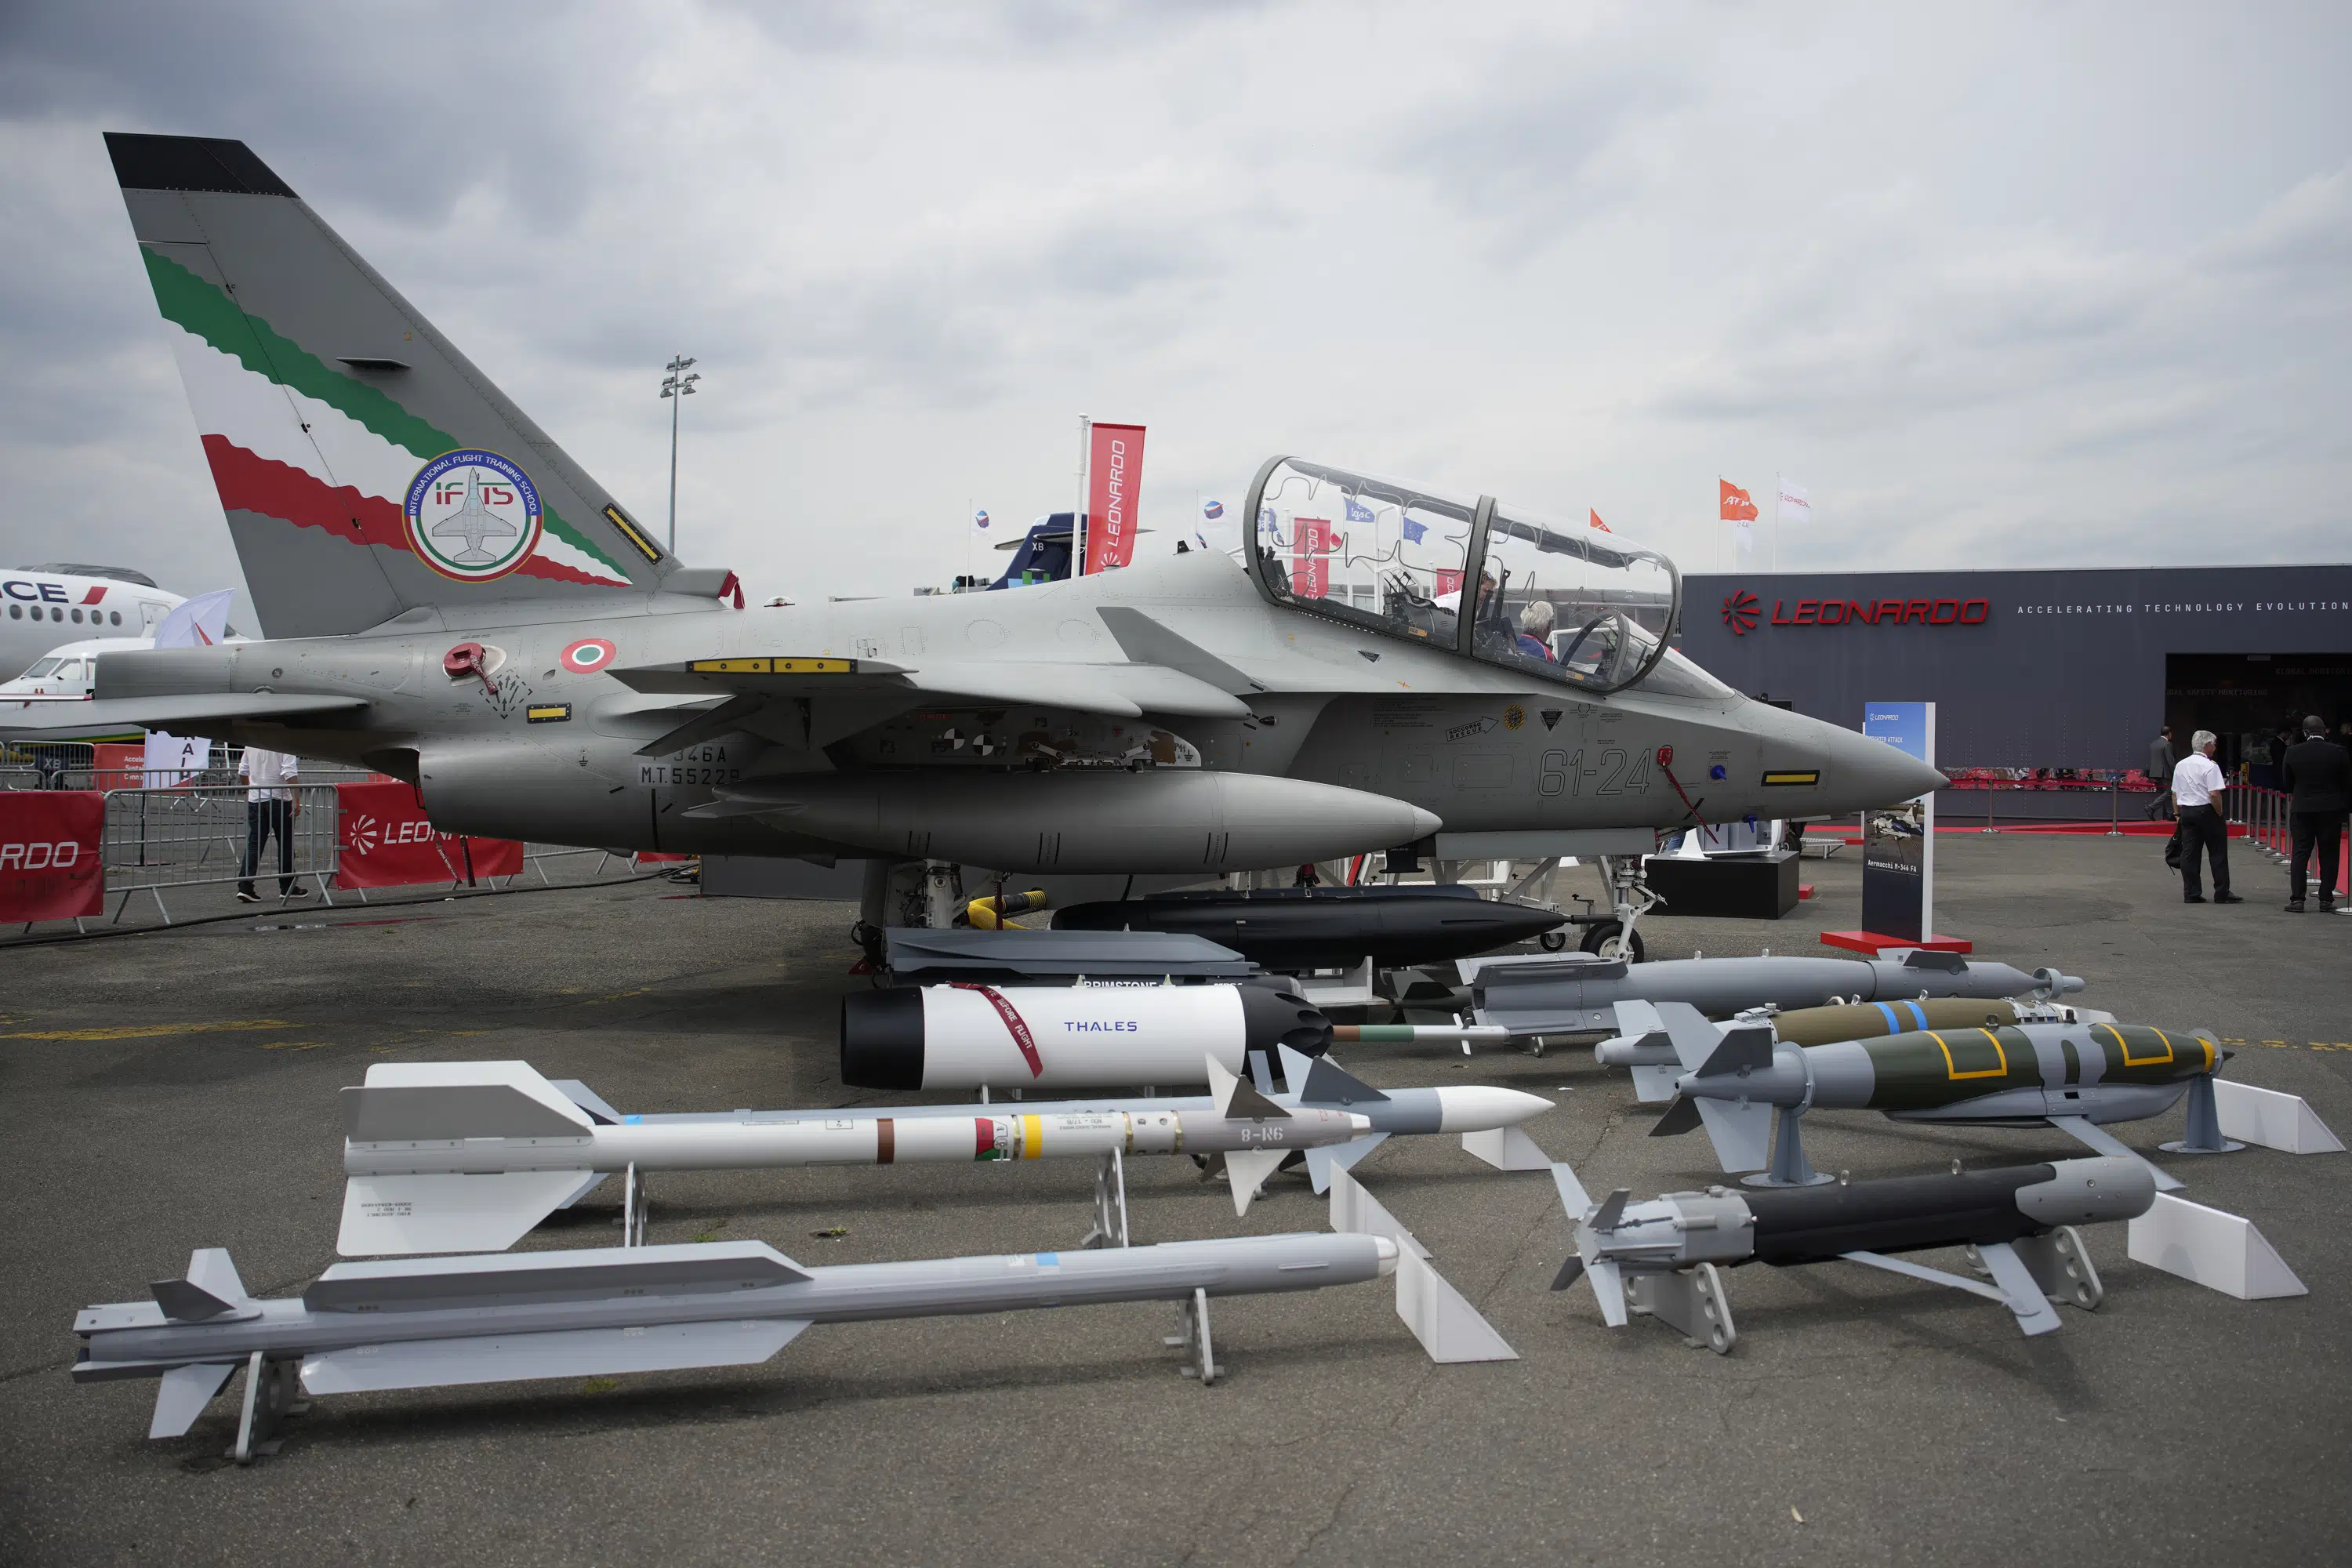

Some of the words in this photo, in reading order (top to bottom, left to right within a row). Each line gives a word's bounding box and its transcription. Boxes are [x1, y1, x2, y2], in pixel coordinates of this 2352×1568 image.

[409, 459, 452, 514] INTERNATIONAL
[452, 455, 483, 464] FLIGHT
[486, 456, 521, 481] TRAINING
[519, 481, 537, 514] SCHOOL
[1108, 440, 1124, 546] LEONARDO
[0, 581, 69, 603] CE
[1770, 599, 1989, 625] LEONARDO
[2017, 605, 2132, 614] ACCELERATING
[2145, 603, 2243, 612] TECHNOLOGY
[2256, 601, 2349, 611] EVOLUTION
[1449, 722, 1481, 735] SOCCORSO
[1450, 726, 1482, 739] RESCUE
[653, 746, 726, 763] 346A
[1538, 749, 1651, 797] 61-24
[1867, 859, 1893, 869] Aermacchi
[996, 998, 1018, 1022] BEFORE
[1014, 1024, 1033, 1049] FLIGHT
[1064, 1022, 1138, 1032] THALES
